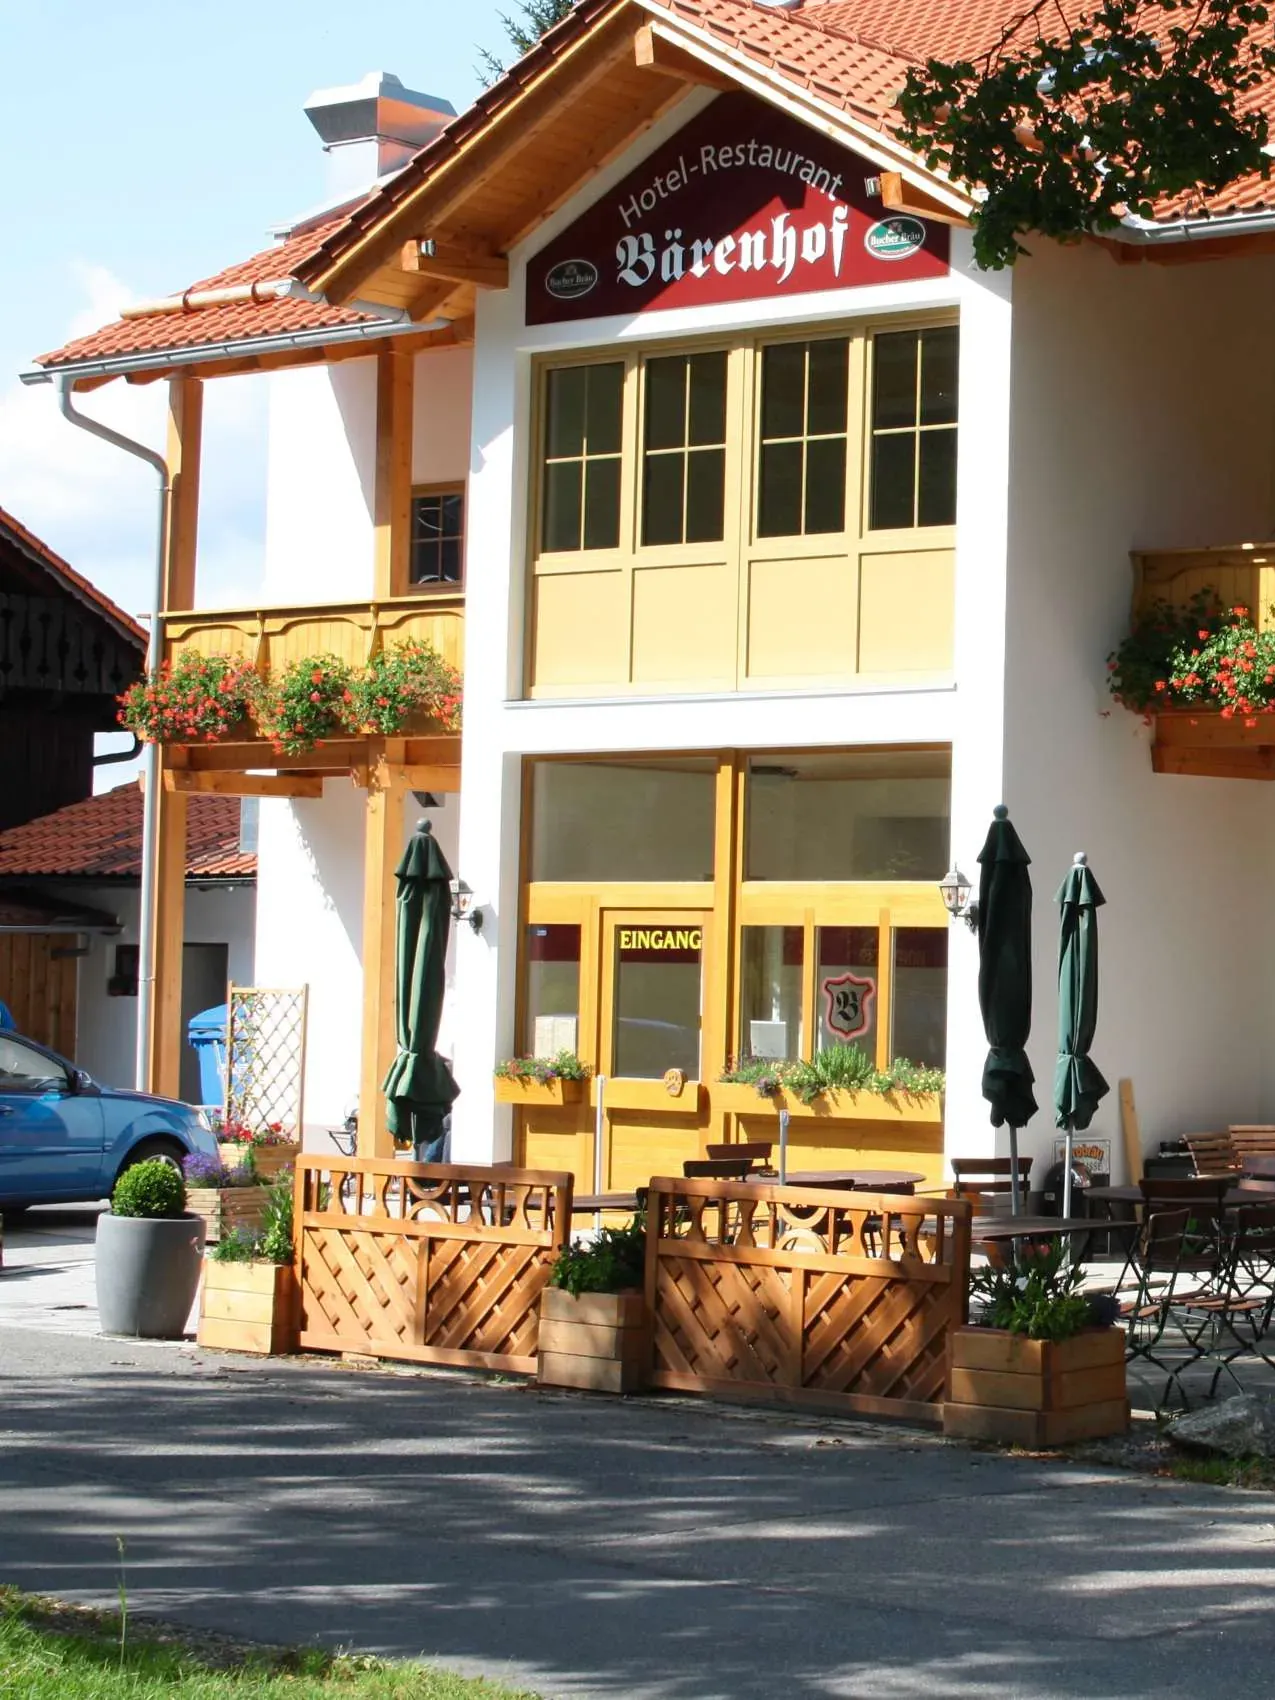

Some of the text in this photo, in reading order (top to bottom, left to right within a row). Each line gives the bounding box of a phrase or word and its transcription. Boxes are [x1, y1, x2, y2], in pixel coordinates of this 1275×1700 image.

[619, 138, 844, 228] Hotel-Restaurant
[615, 204, 849, 286] Bärenhof
[619, 929, 702, 950] EINGANG
